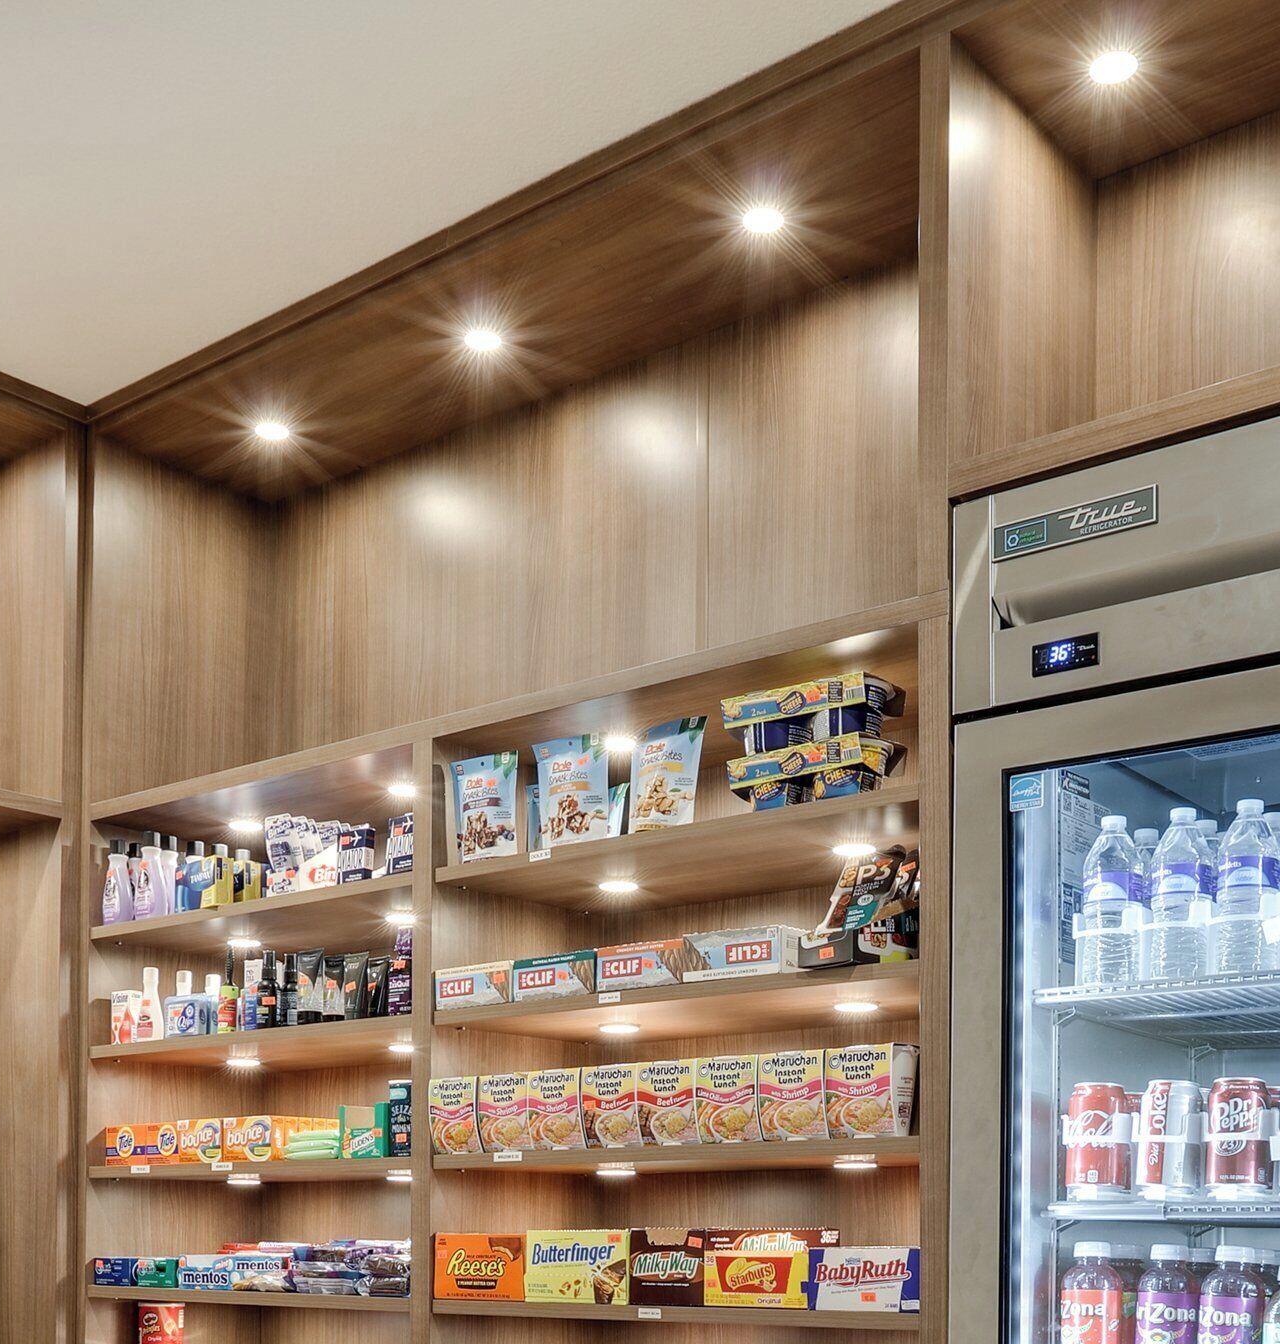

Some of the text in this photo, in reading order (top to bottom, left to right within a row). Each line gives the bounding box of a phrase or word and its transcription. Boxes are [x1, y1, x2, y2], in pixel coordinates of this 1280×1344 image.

[1080, 516, 1133, 535] REFRIGERATOR
[1049, 644, 1067, 663] 36
[781, 697, 803, 714] CHEESE
[645, 743, 666, 752] Dole
[552, 761, 572, 771] Dole
[783, 756, 804, 775] CHEESE
[610, 960, 641, 975] CLIF
[526, 971, 554, 986] CLIF
[448, 980, 472, 995] CLIF
[488, 1078, 525, 1088] Maruchan
[538, 1074, 575, 1085] Maruchan
[593, 1070, 632, 1081] Maruchan
[439, 1081, 471, 1091] Maruchan
[541, 1085, 565, 1093] Instant
[440, 1092, 463, 1100] Instant
[657, 1096, 672, 1106] Beef
[546, 1101, 568, 1113] Shrimp
[1230, 1097, 1251, 1113] Dr
[117, 1133, 133, 1150] Tide
[159, 1132, 175, 1149] Tide
[181, 1129, 213, 1149] bounce
[227, 1126, 263, 1147] bounce
[351, 1130, 375, 1151] LUDEN'S
[532, 1242, 615, 1266] Butterfinger
[236, 1260, 280, 1270] mentos
[447, 1249, 507, 1277] Reese's
[183, 1272, 228, 1285] mentos
[730, 1263, 774, 1288] Starburst
